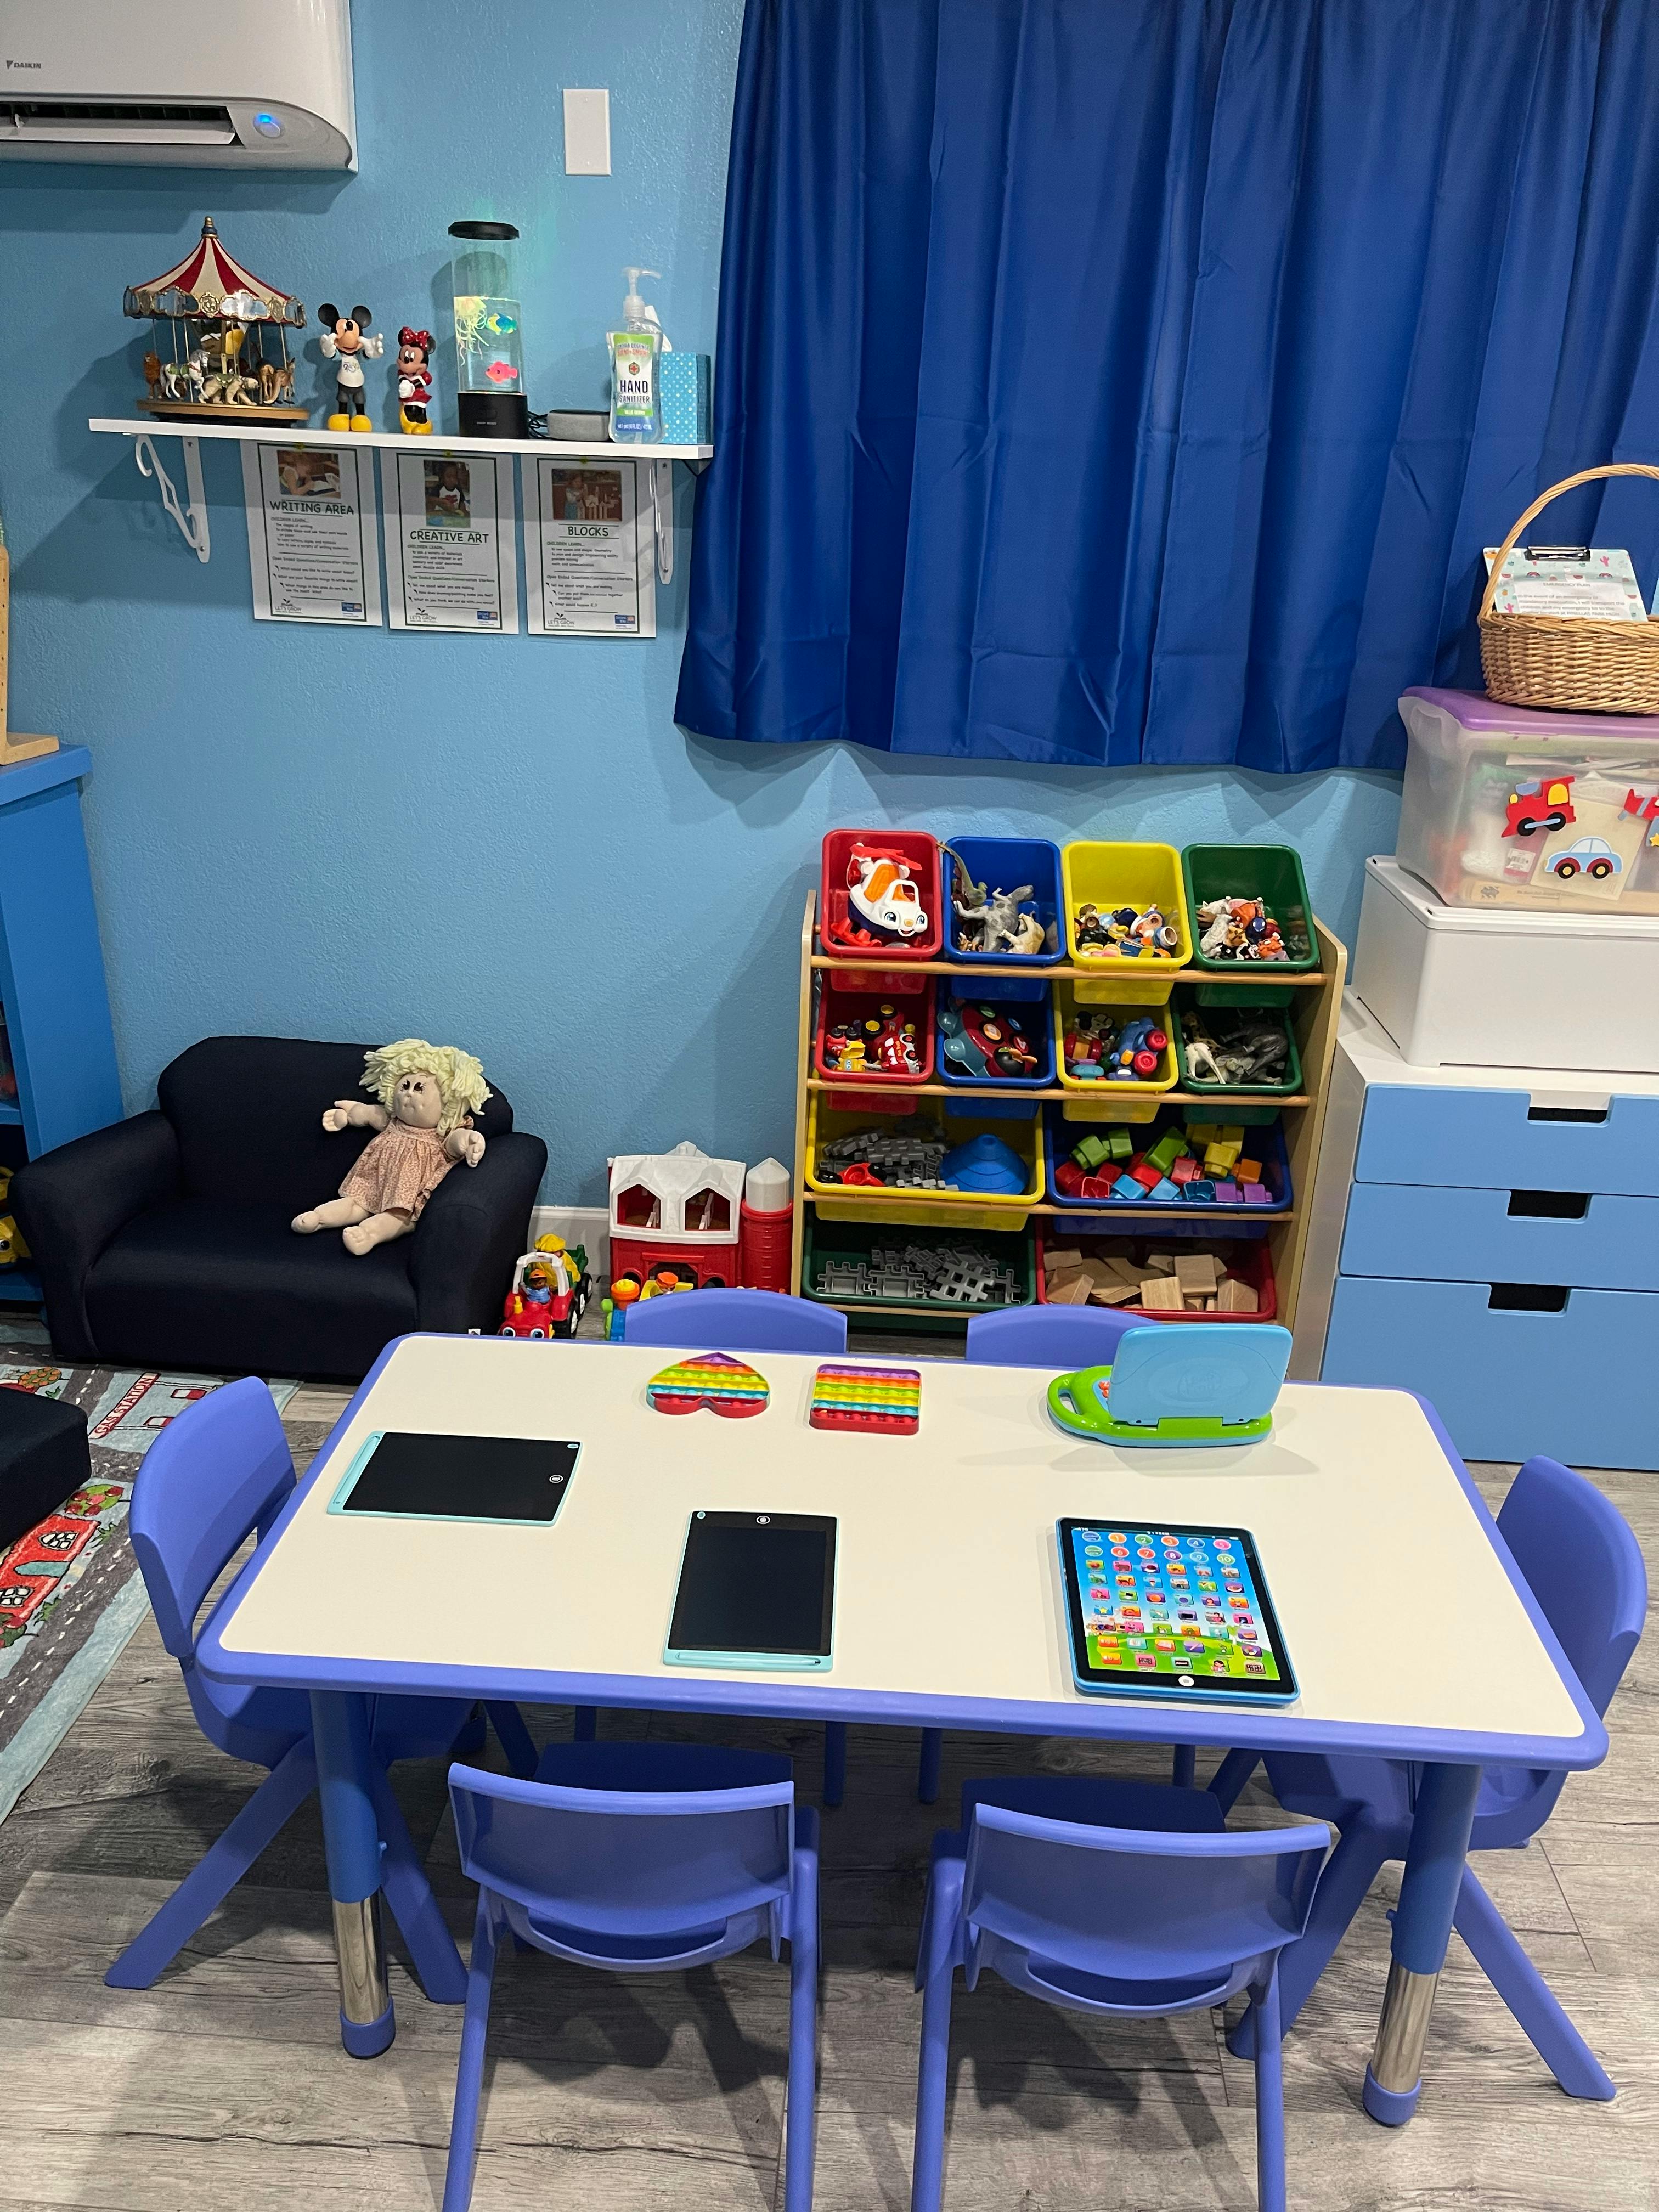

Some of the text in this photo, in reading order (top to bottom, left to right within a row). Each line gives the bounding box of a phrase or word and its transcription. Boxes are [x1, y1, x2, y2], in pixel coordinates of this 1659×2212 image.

[620, 380, 648, 393] HAND
[619, 395, 650, 404] SANITIZER
[269, 500, 354, 515] WRITING AREA
[410, 530, 490, 543] CREATIVE ART
[568, 526, 609, 537] BLOCKS
[94, 1378, 154, 1434] GAS STATION
